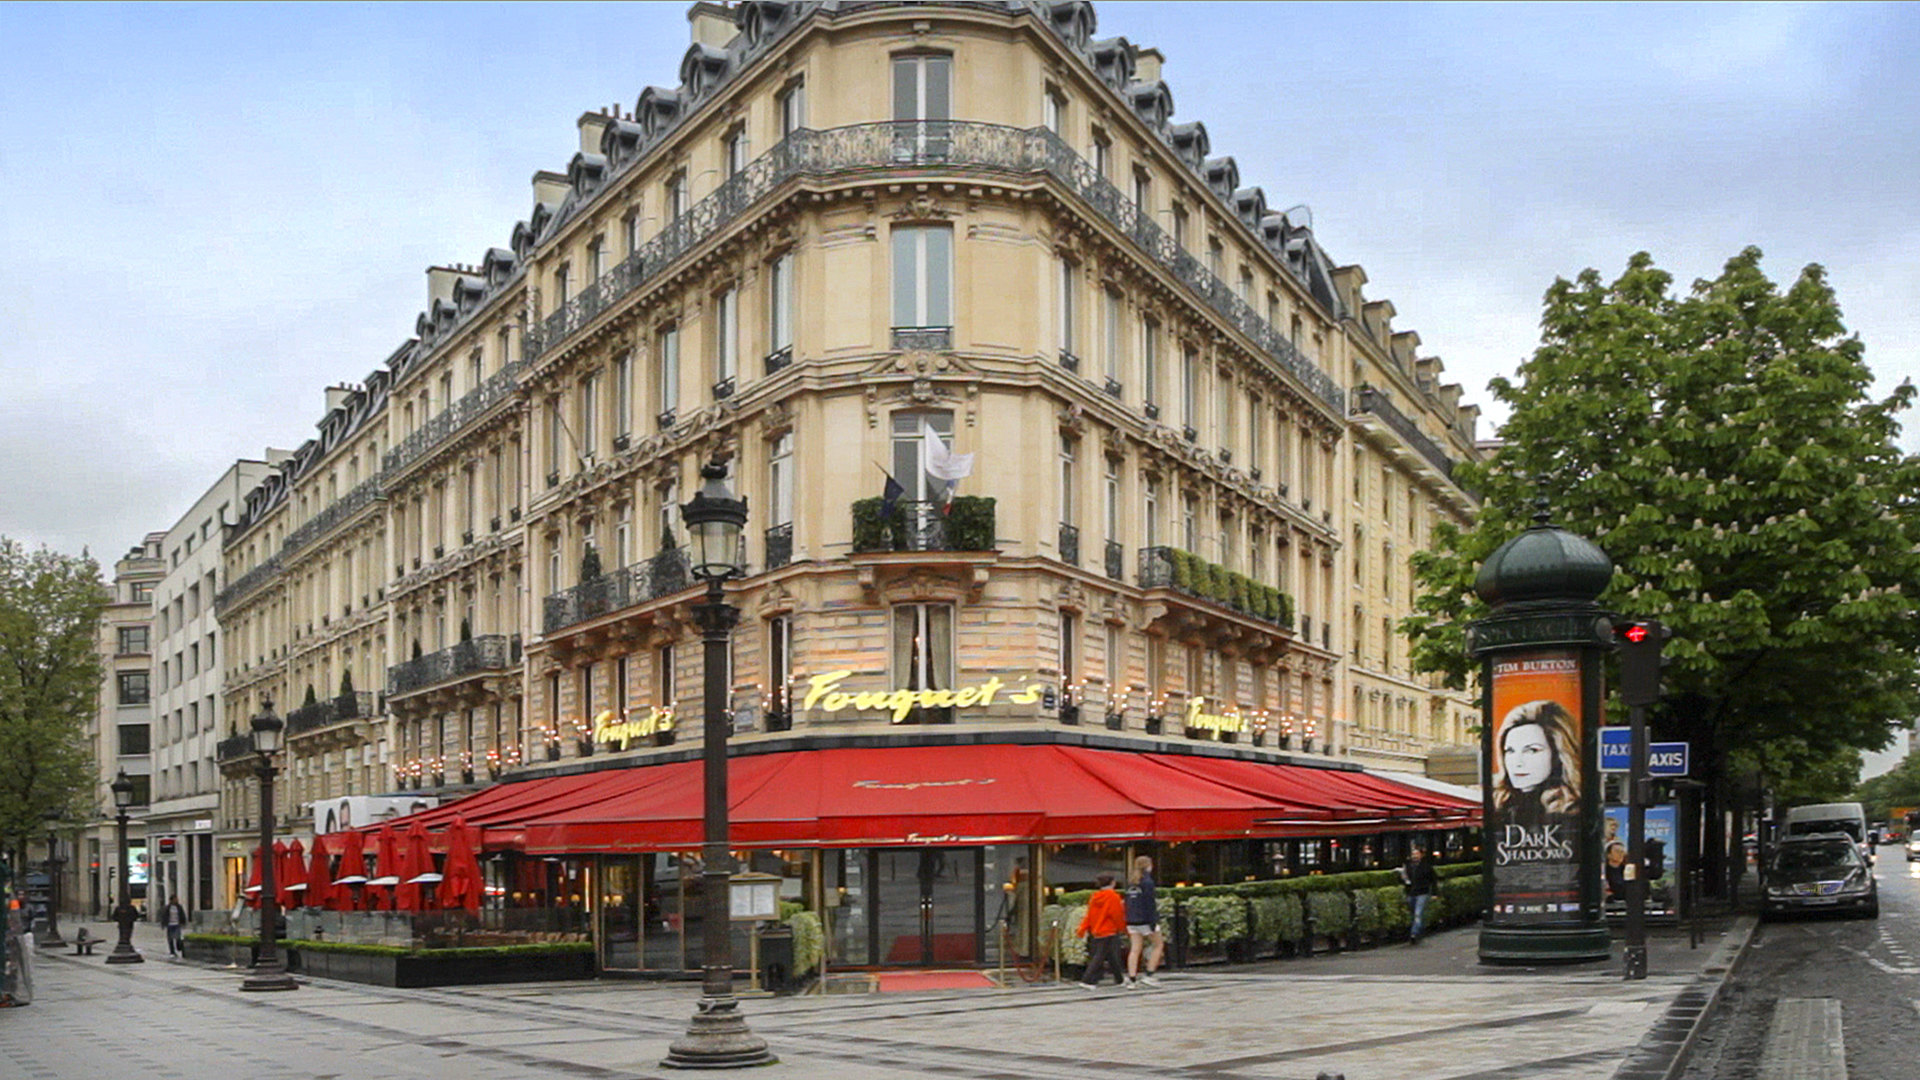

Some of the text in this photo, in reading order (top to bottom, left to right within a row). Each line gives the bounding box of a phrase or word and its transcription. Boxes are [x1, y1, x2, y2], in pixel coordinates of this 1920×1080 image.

[1498, 660, 1576, 673] TIM BURTON
[804, 670, 1041, 722] Fouquet's
[1649, 753, 1683, 766] AXIS
